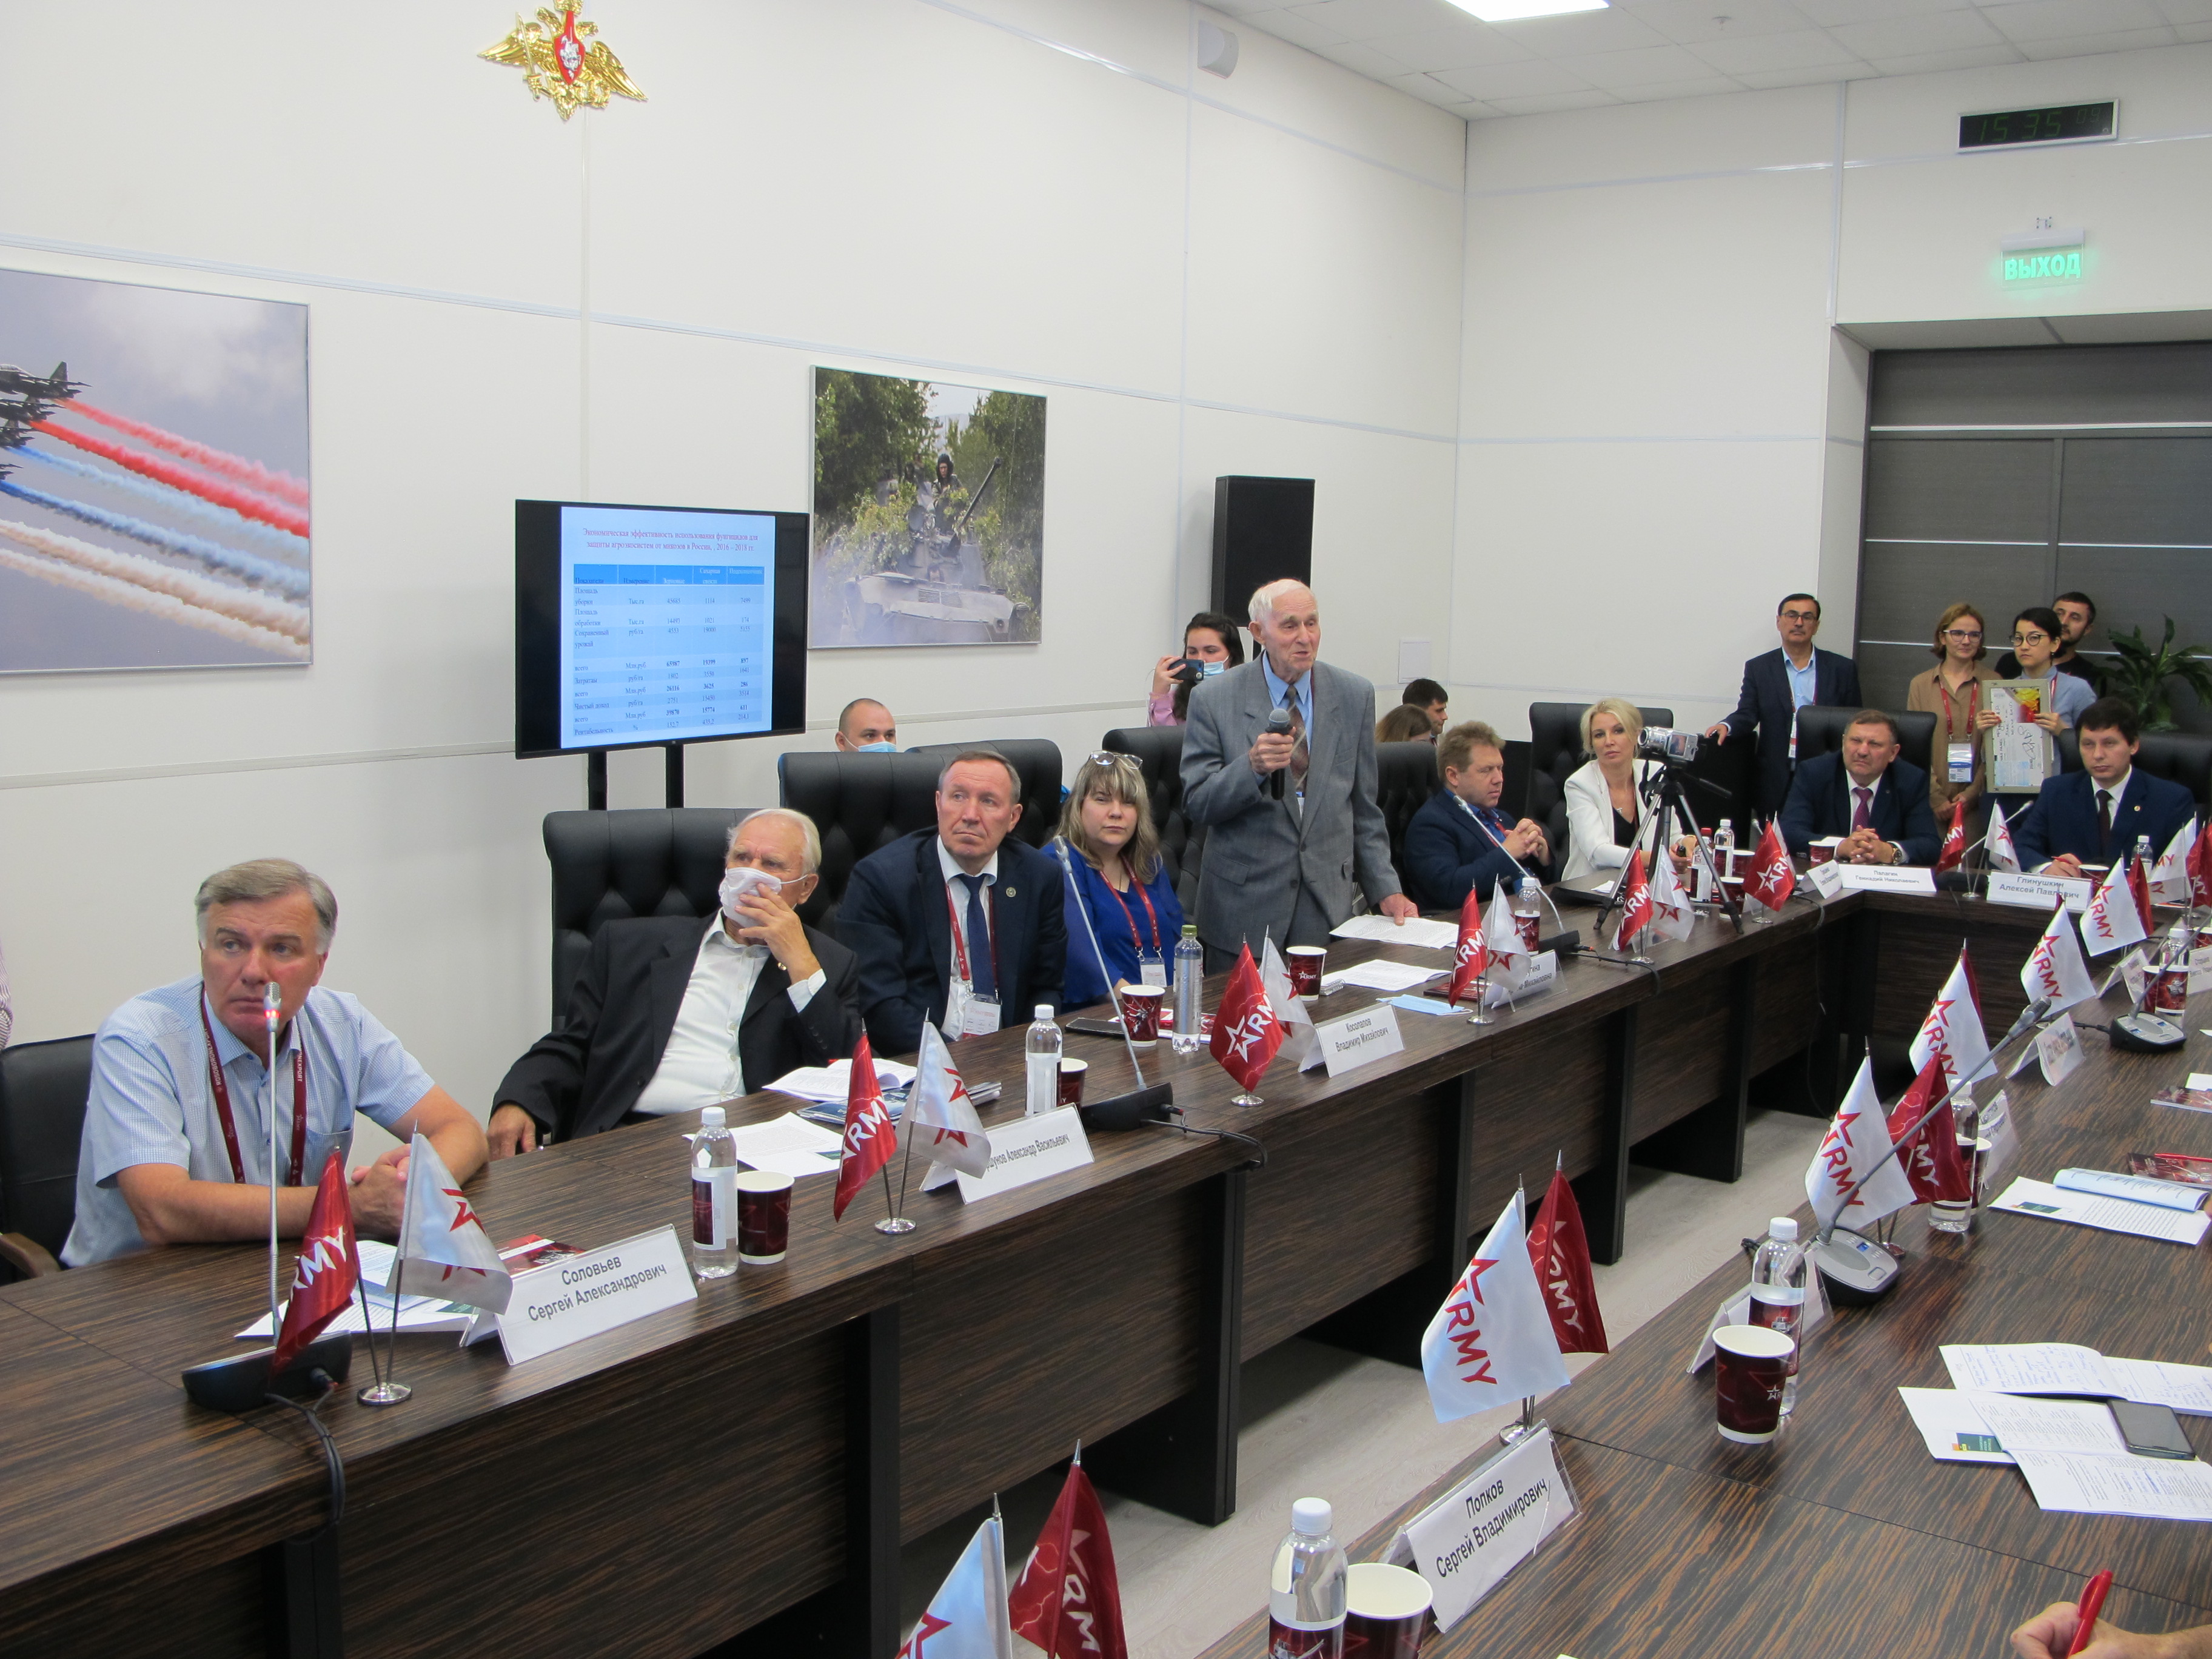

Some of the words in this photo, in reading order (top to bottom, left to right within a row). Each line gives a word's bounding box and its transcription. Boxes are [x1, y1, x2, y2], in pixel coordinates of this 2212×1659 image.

[2005, 253, 2081, 280] ВЫХОД
[583, 528, 628, 537] Экономическая
[631, 530, 673, 538] эффективность
[1999, 883, 2034, 894] Алексей
[2017, 876, 2064, 888] Глинушкин
[1299, 971, 1316, 979] ARMY
[1335, 1037, 1361, 1052] Владимир
[1006, 1144, 1037, 1162] Александр
[1034, 1134, 1070, 1152] Васильевич
[561, 1256, 622, 1285] Соловьев
[528, 1293, 574, 1321] Сергей
[575, 1264, 667, 1305] Александрович
[1445, 1257, 1500, 1384] ARMY
[1466, 1480, 1504, 1518] Попков
[1436, 1533, 1475, 1578] Сергей
[1472, 1478, 1548, 1547] Владимирович
